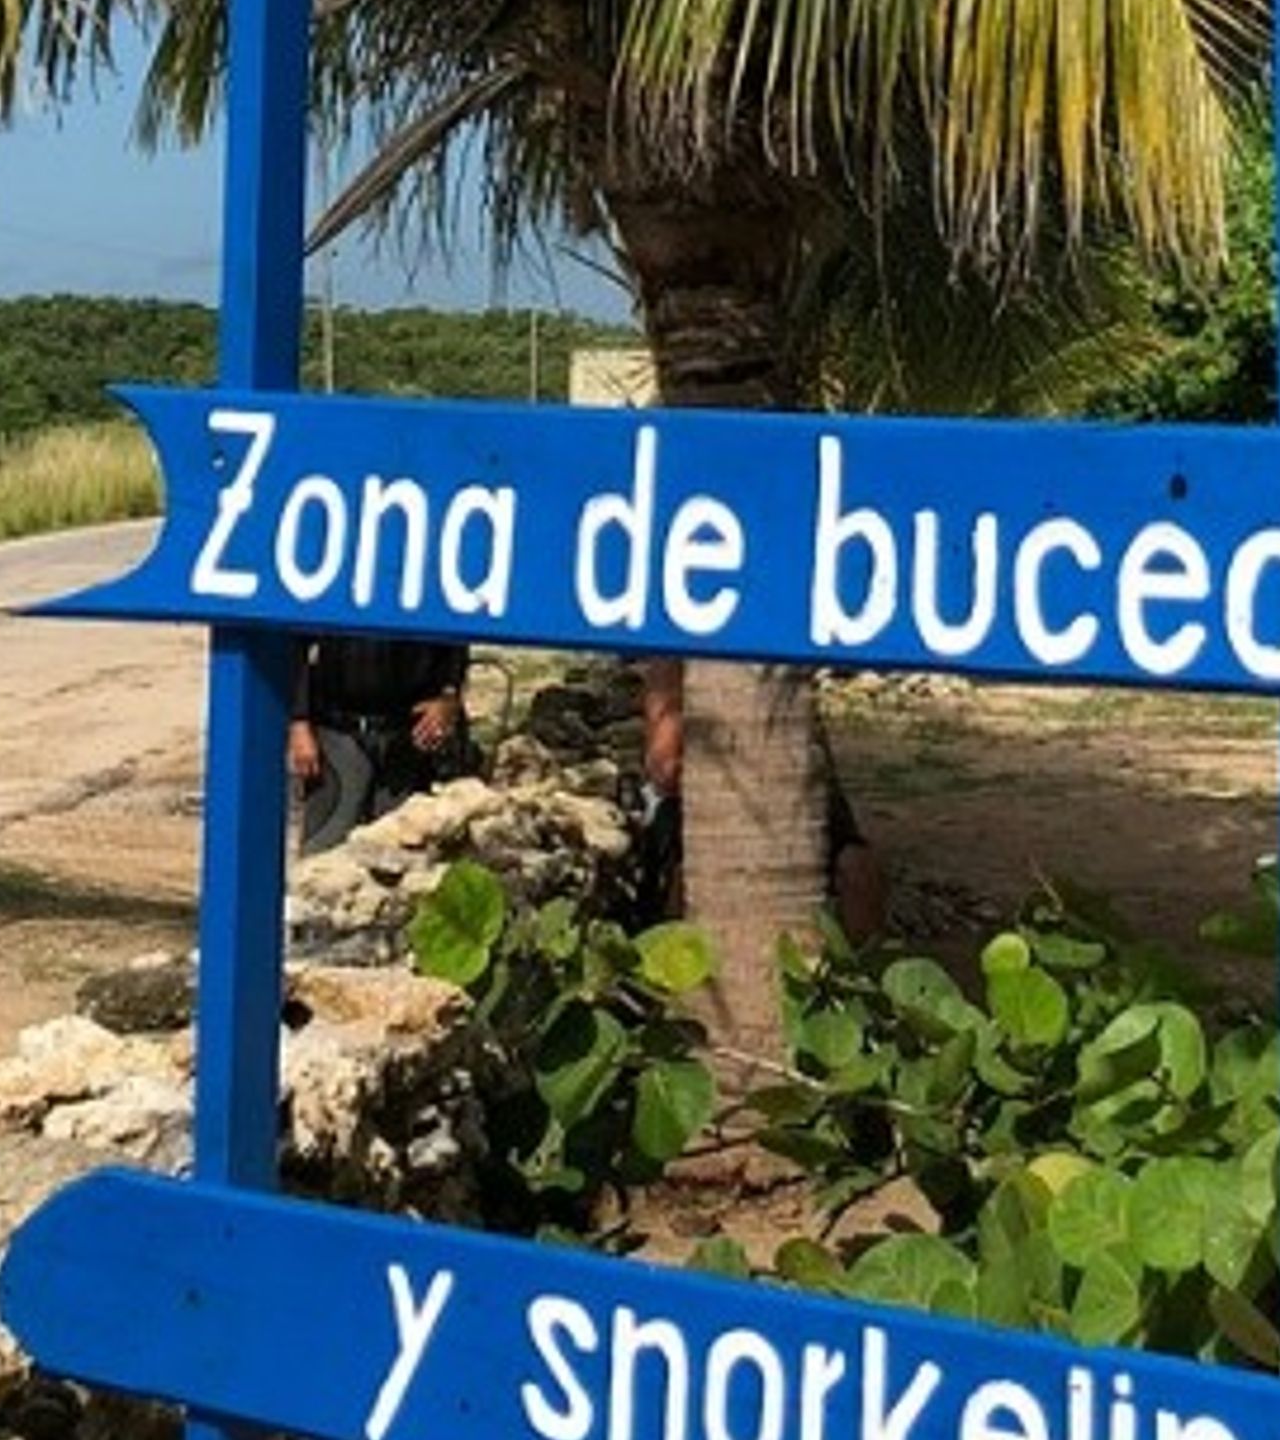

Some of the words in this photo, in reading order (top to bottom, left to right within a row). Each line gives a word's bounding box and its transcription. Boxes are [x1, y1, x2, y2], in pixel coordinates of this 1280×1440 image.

[190, 409, 516, 619] Zona
[575, 425, 745, 637] de
[365, 1263, 454, 1440] y
